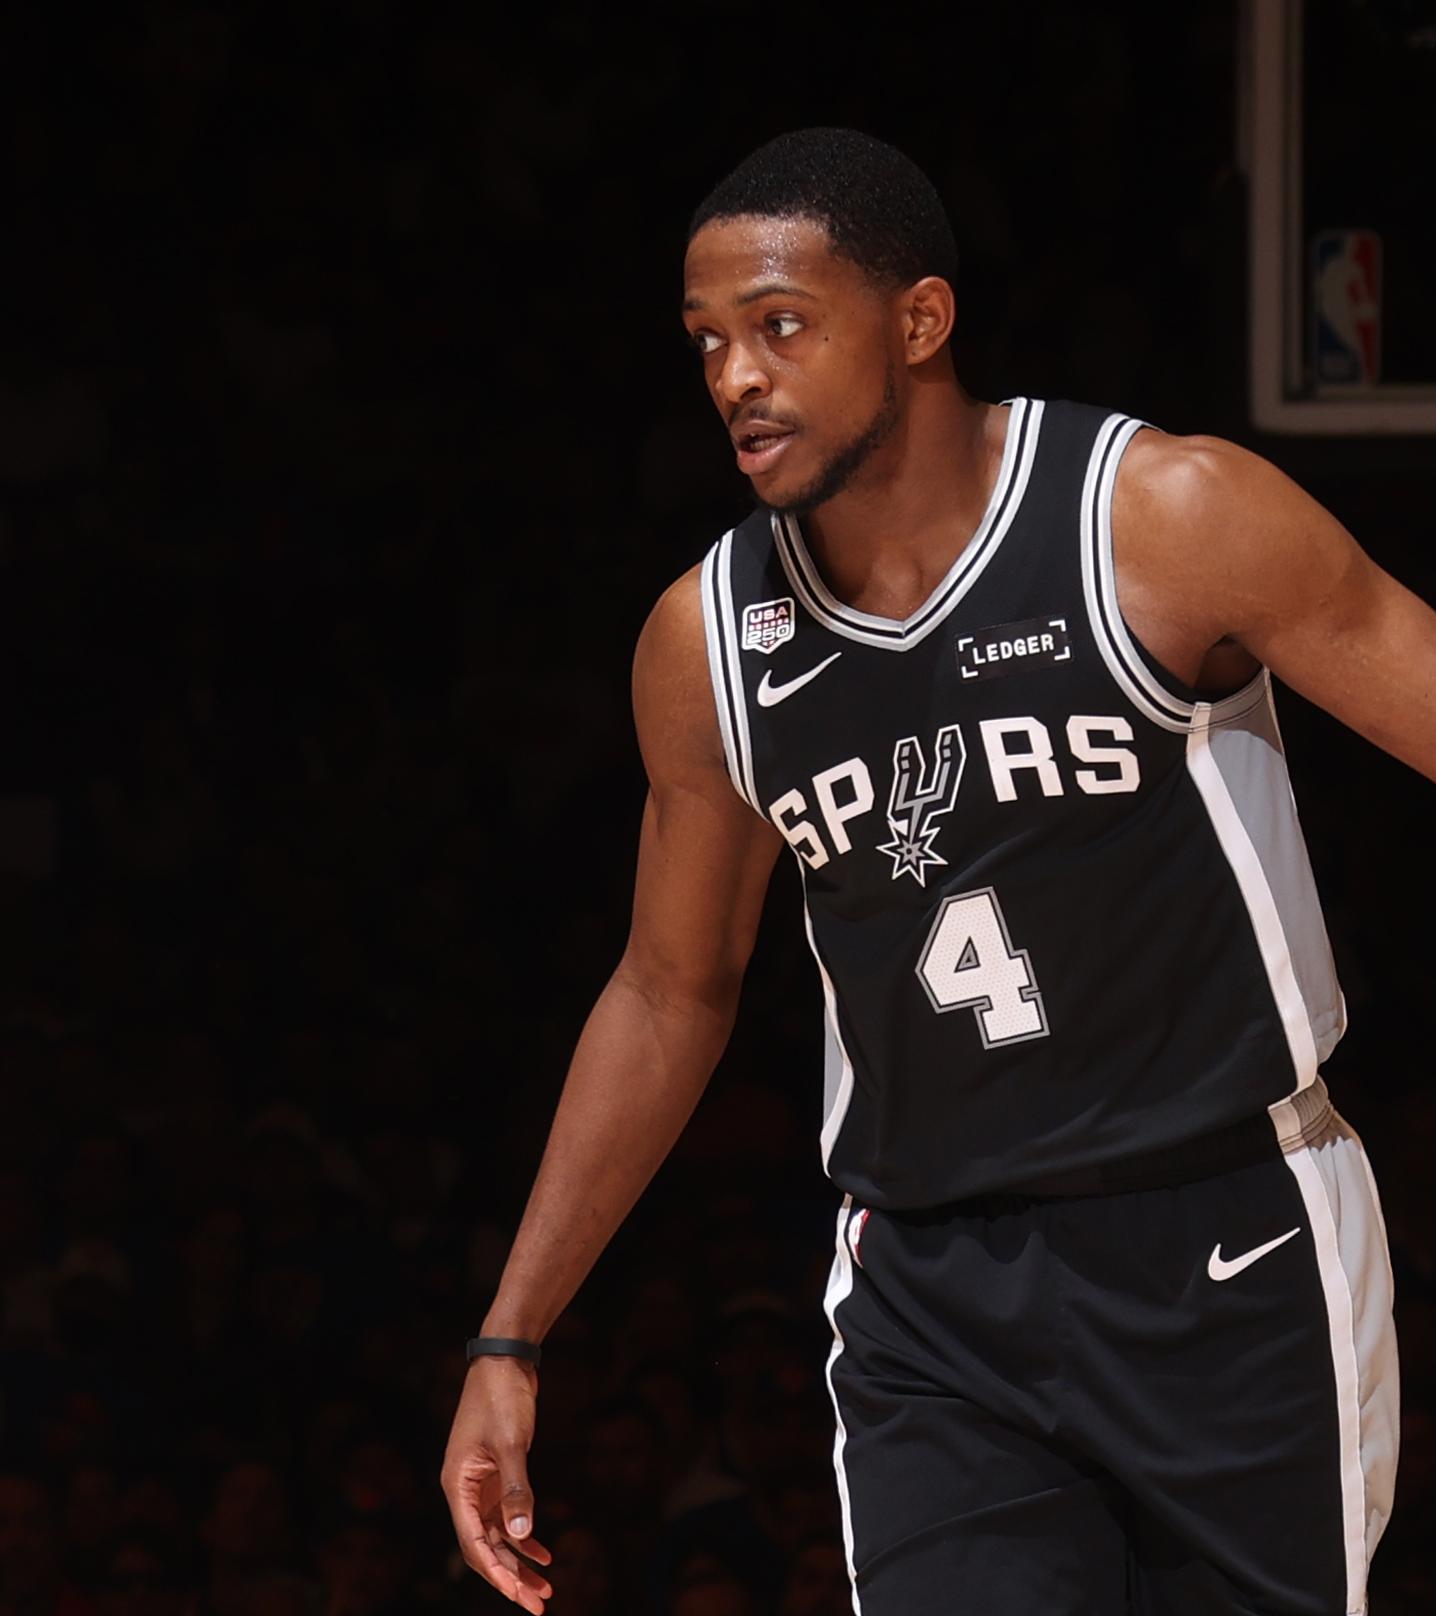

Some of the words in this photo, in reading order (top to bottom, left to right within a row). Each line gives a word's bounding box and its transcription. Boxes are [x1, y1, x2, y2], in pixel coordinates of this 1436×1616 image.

[750, 606, 788, 624] USA
[747, 624, 790, 645] 250
[972, 633, 1055, 665] LEDGER
[915, 886, 1051, 1050] 4
